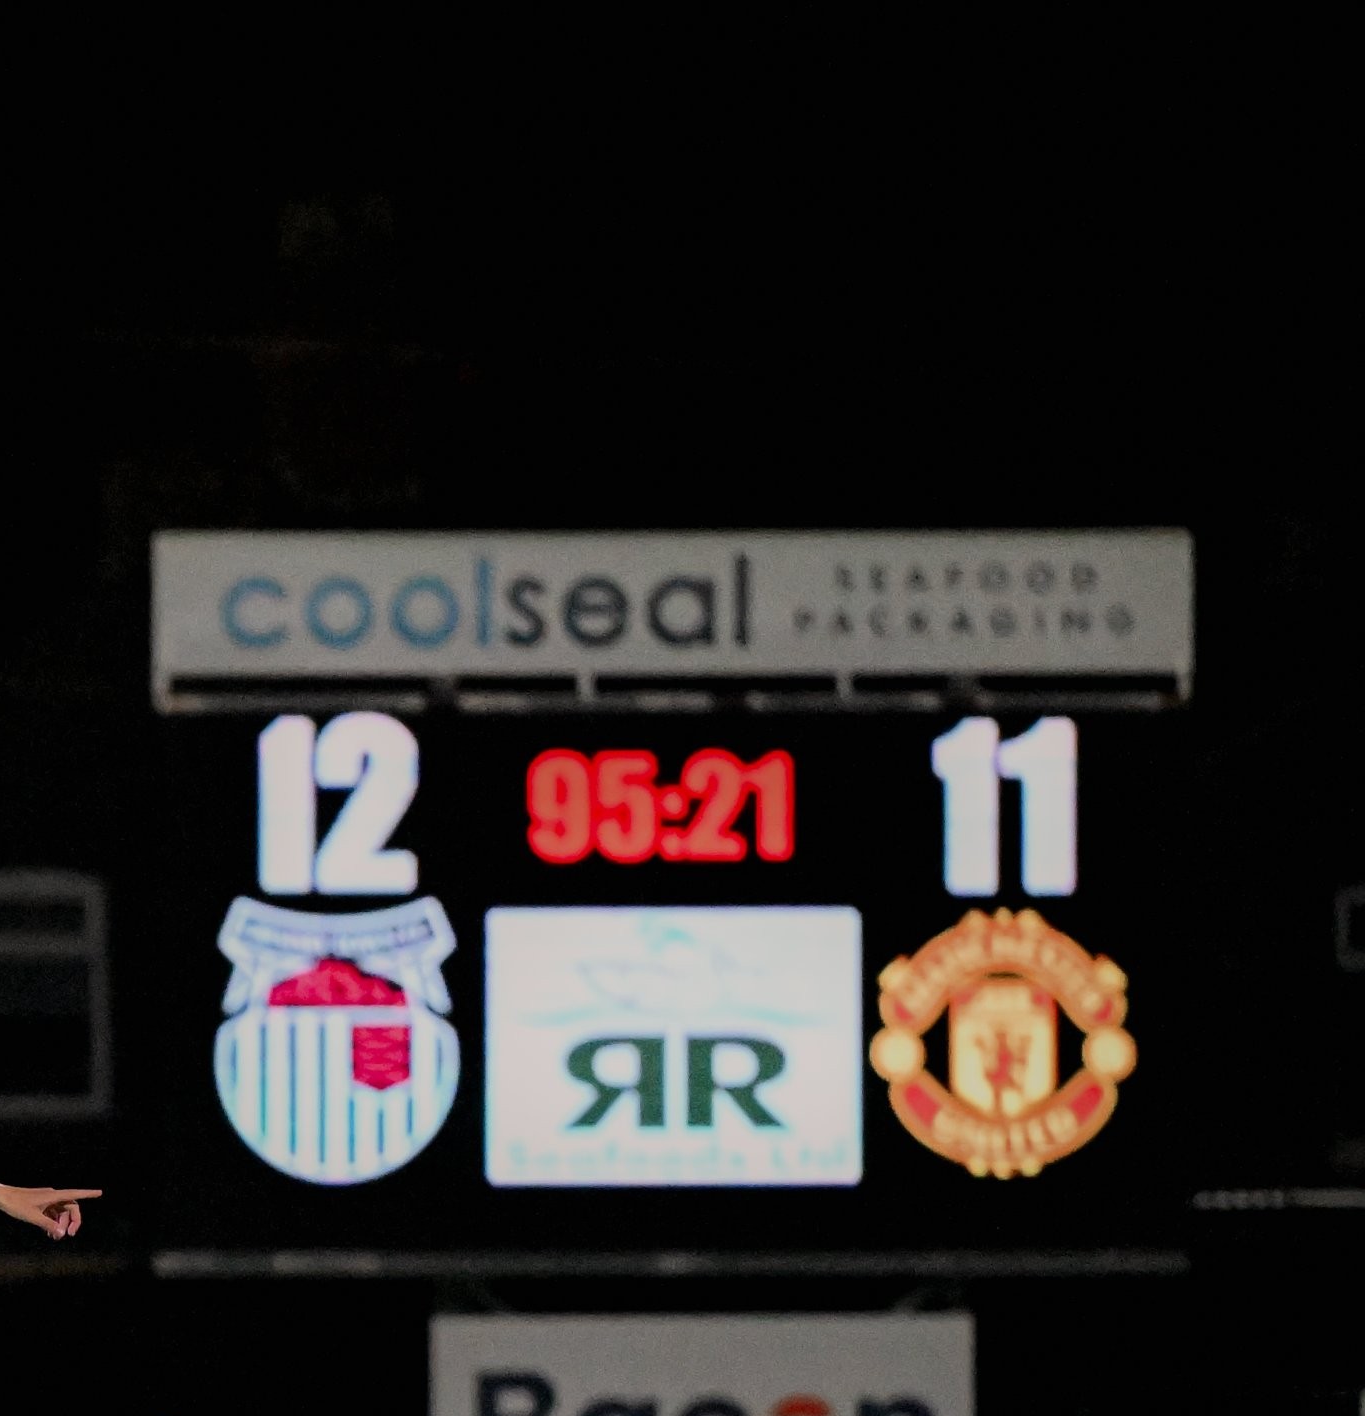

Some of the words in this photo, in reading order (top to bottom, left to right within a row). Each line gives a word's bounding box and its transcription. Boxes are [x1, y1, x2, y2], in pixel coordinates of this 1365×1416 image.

[220, 554, 752, 649] coolseal
[258, 711, 419, 895] 12
[526, 748, 796, 864] 95:21
[931, 715, 1078, 897] 11
